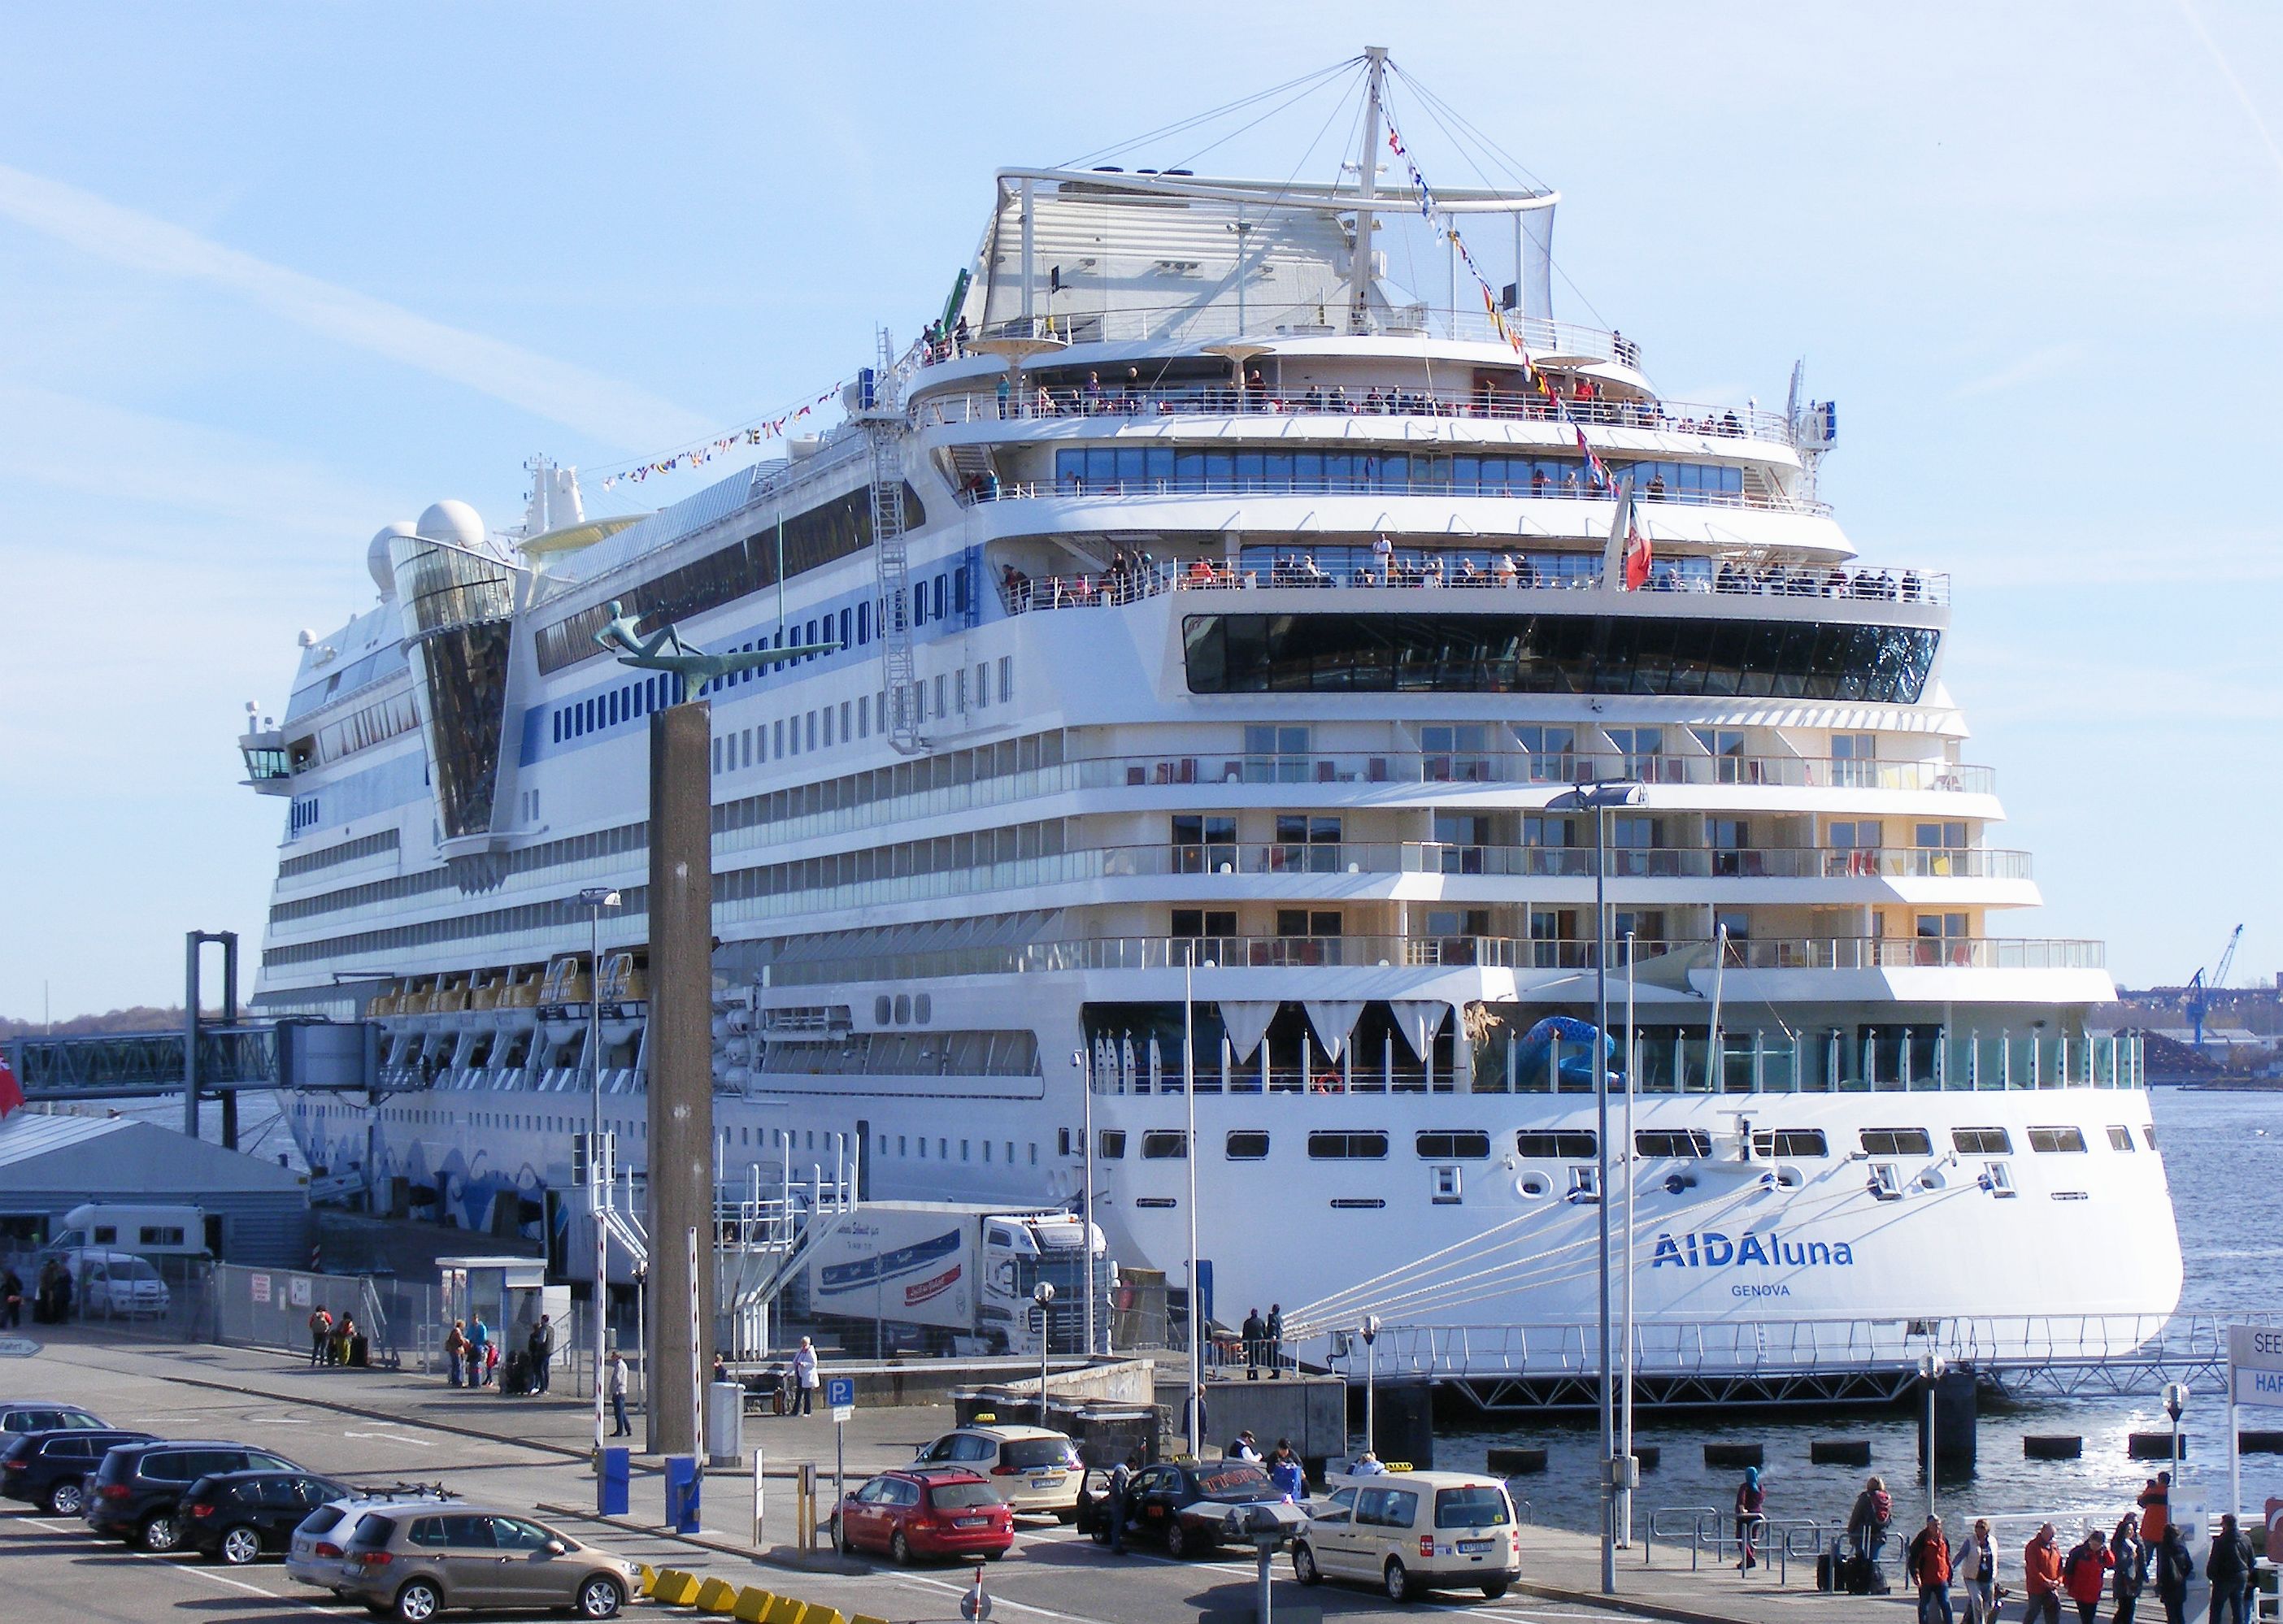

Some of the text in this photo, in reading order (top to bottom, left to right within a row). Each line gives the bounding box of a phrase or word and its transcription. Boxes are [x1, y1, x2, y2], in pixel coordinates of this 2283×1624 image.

[1652, 1231, 1854, 1268] AIDAluna
[1732, 1284, 1790, 1296] GENOVA
[2255, 1332, 2283, 1354] SEE
[833, 1382, 846, 1402] P
